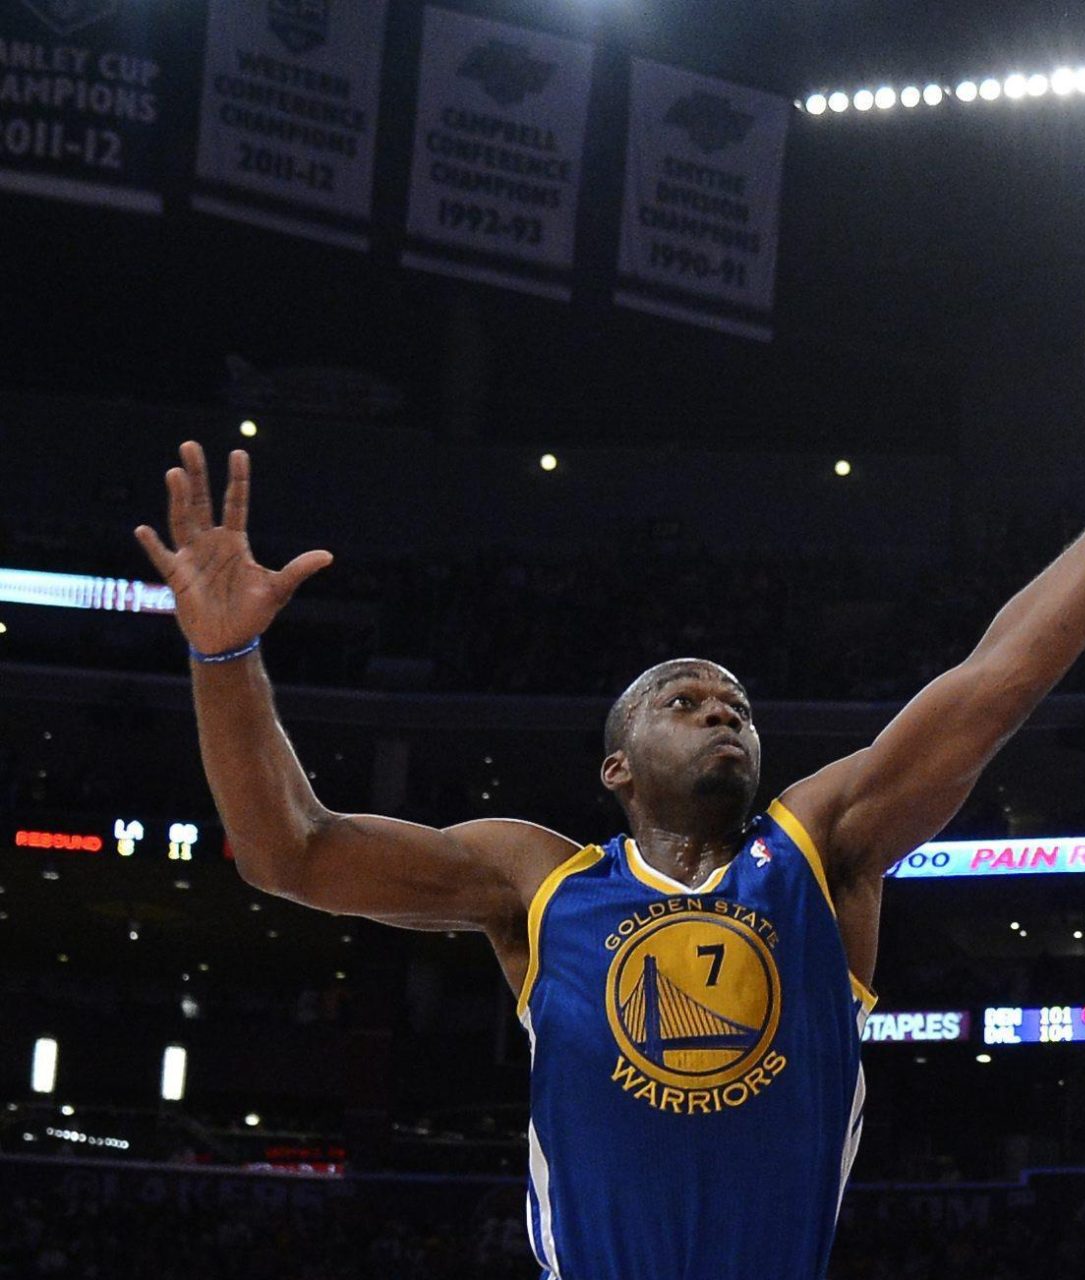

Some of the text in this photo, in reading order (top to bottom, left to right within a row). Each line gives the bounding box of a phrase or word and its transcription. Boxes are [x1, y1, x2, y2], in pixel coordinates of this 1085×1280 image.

[98, 51, 160, 86] CUP
[214, 75, 366, 132] CONFERENCE
[0, 118, 122, 168] 011-12
[219, 103, 358, 159] CHAMPIONS
[426, 130, 571, 181] CONFERENCE
[238, 142, 334, 192] 2011-12
[430, 160, 560, 208] CHAMPIONS
[438, 198, 543, 245] 1992-93
[639, 205, 760, 254] CHAMPIONS
[649, 242, 745, 288] 1990-91
[970, 846, 1060, 870] PAIN
[604, 898, 780, 950] GOLDEN STATE
[696, 944, 725, 986] 7
[1040, 1006, 1071, 1025] 101
[610, 1050, 788, 1114] WARRIORS
